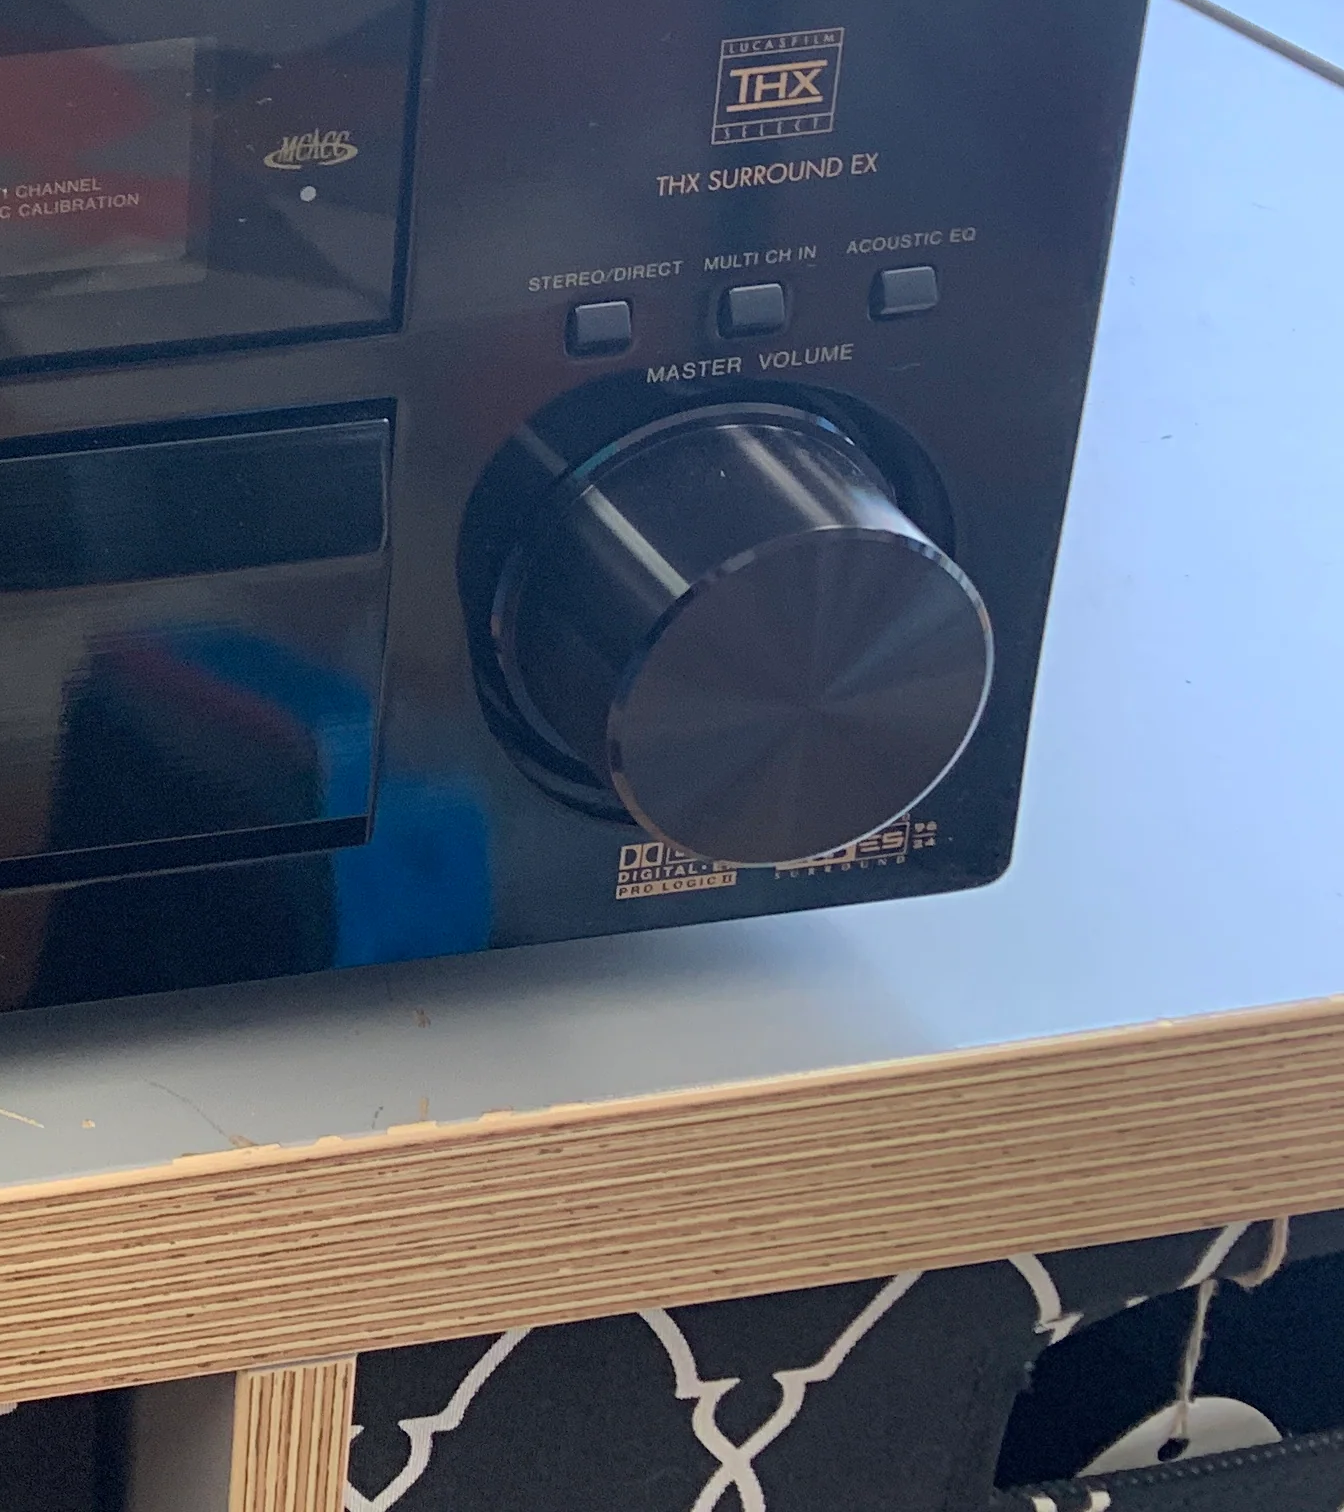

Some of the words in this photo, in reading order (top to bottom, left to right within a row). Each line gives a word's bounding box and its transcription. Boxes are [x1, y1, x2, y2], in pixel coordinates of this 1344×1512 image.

[728, 33, 835, 54] LUCASFILM
[725, 59, 828, 112] THX
[723, 117, 819, 140] SELECT
[15, 177, 102, 199] CHANNEL
[656, 174, 701, 198] THX
[708, 155, 843, 193] SURROUND
[850, 152, 879, 176] EX
[18, 192, 140, 219] CALIBRATION
[846, 230, 944, 256] ACOUSTIC
[950, 226, 977, 245] EQ
[704, 252, 760, 273] MULTI
[765, 248, 792, 266] CH
[798, 245, 818, 262] IN
[527, 259, 683, 293] STEREO/DIRECT
[646, 356, 742, 384] MASTER
[758, 343, 854, 371] VOLUME
[617, 865, 697, 885] DIGITAL
[773, 854, 906, 881] SURROUND
[617, 880, 653, 897] PRO
[661, 875, 716, 891] LOGIC
